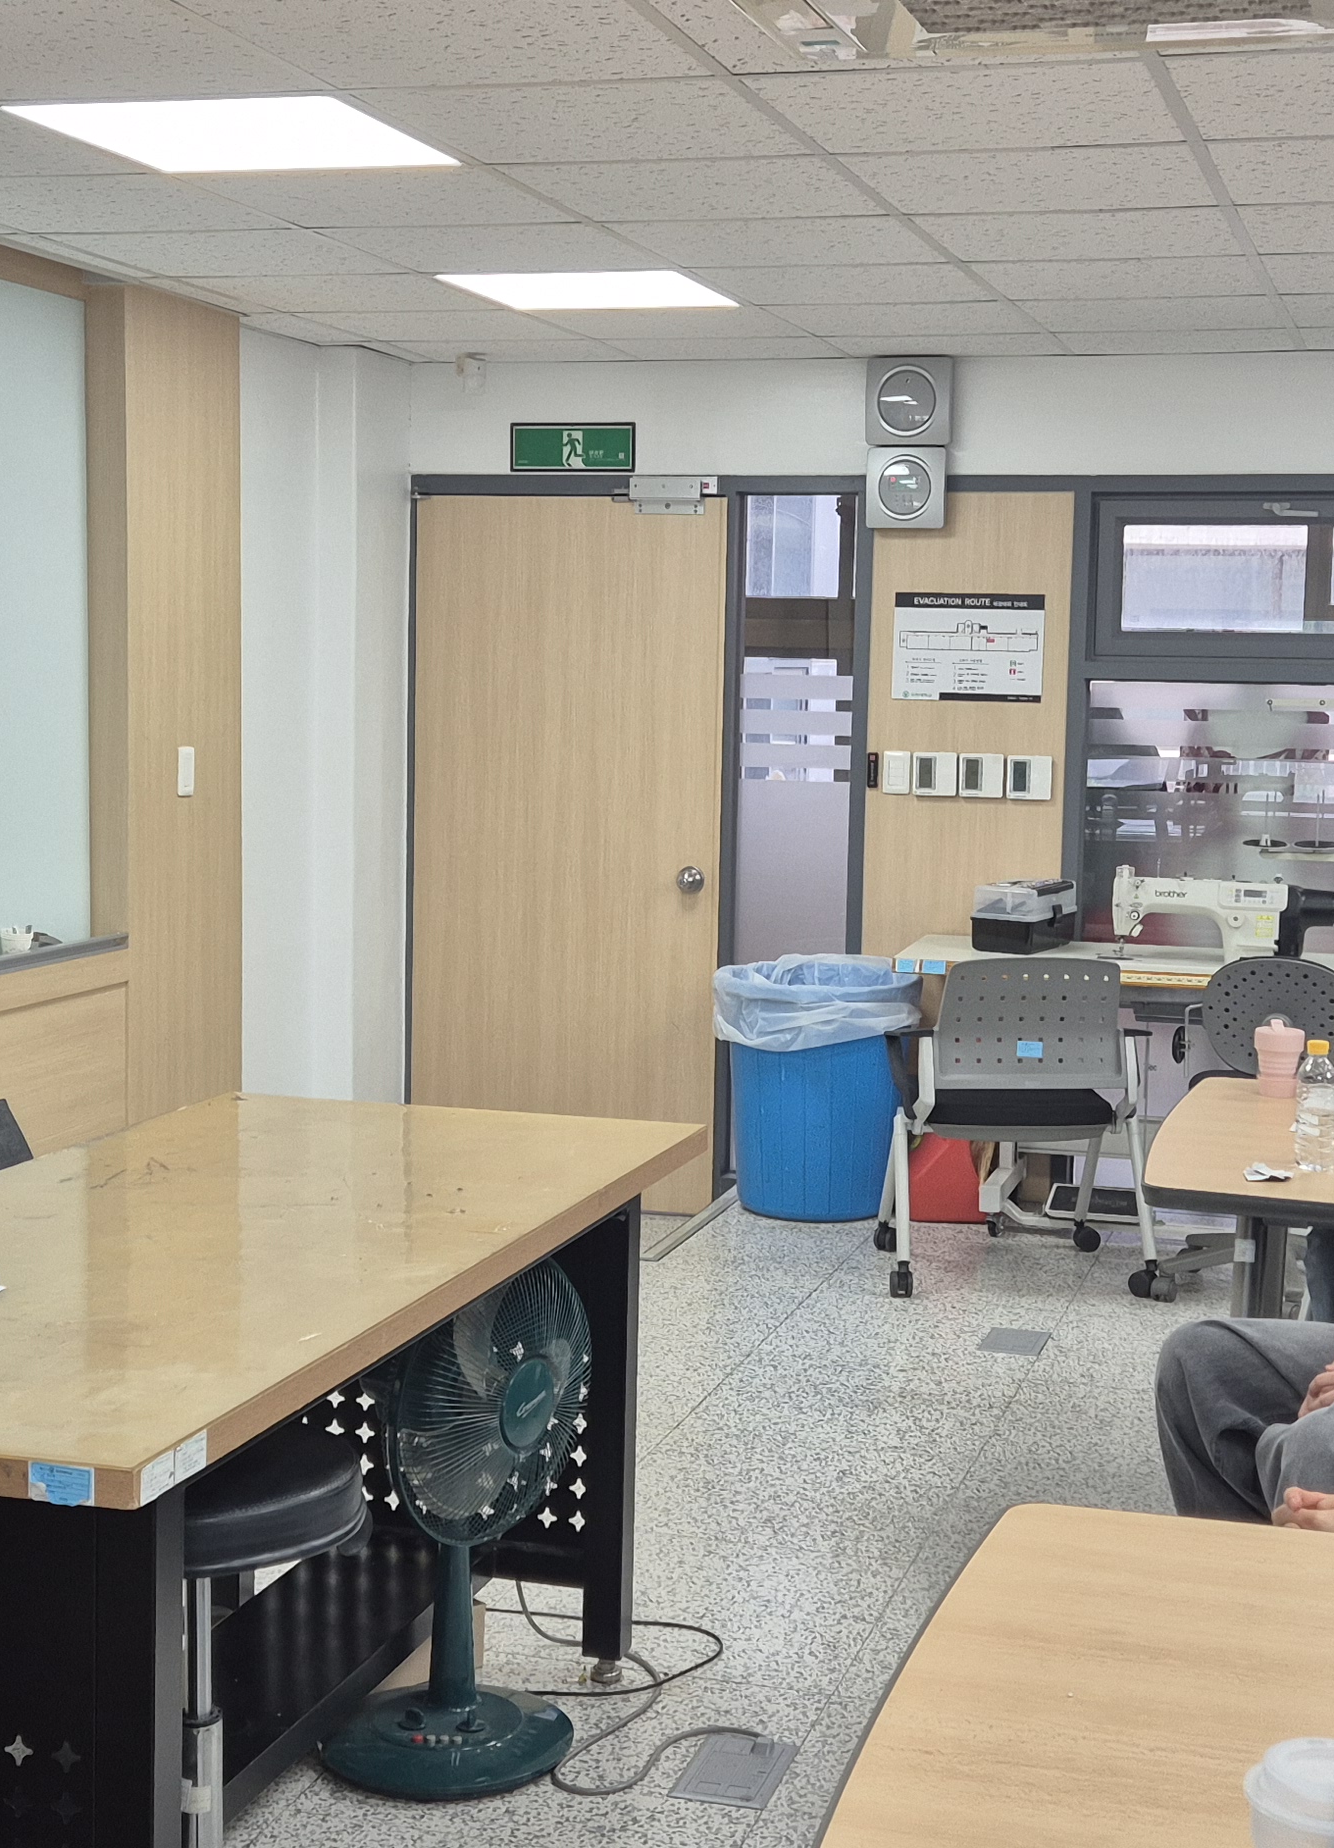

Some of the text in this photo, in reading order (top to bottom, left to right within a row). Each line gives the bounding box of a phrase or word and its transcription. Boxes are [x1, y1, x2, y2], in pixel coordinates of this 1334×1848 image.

[913, 596, 962, 606] EVACUATION
[964, 597, 991, 606] ROUTE
[1154, 889, 1188, 899] brother
